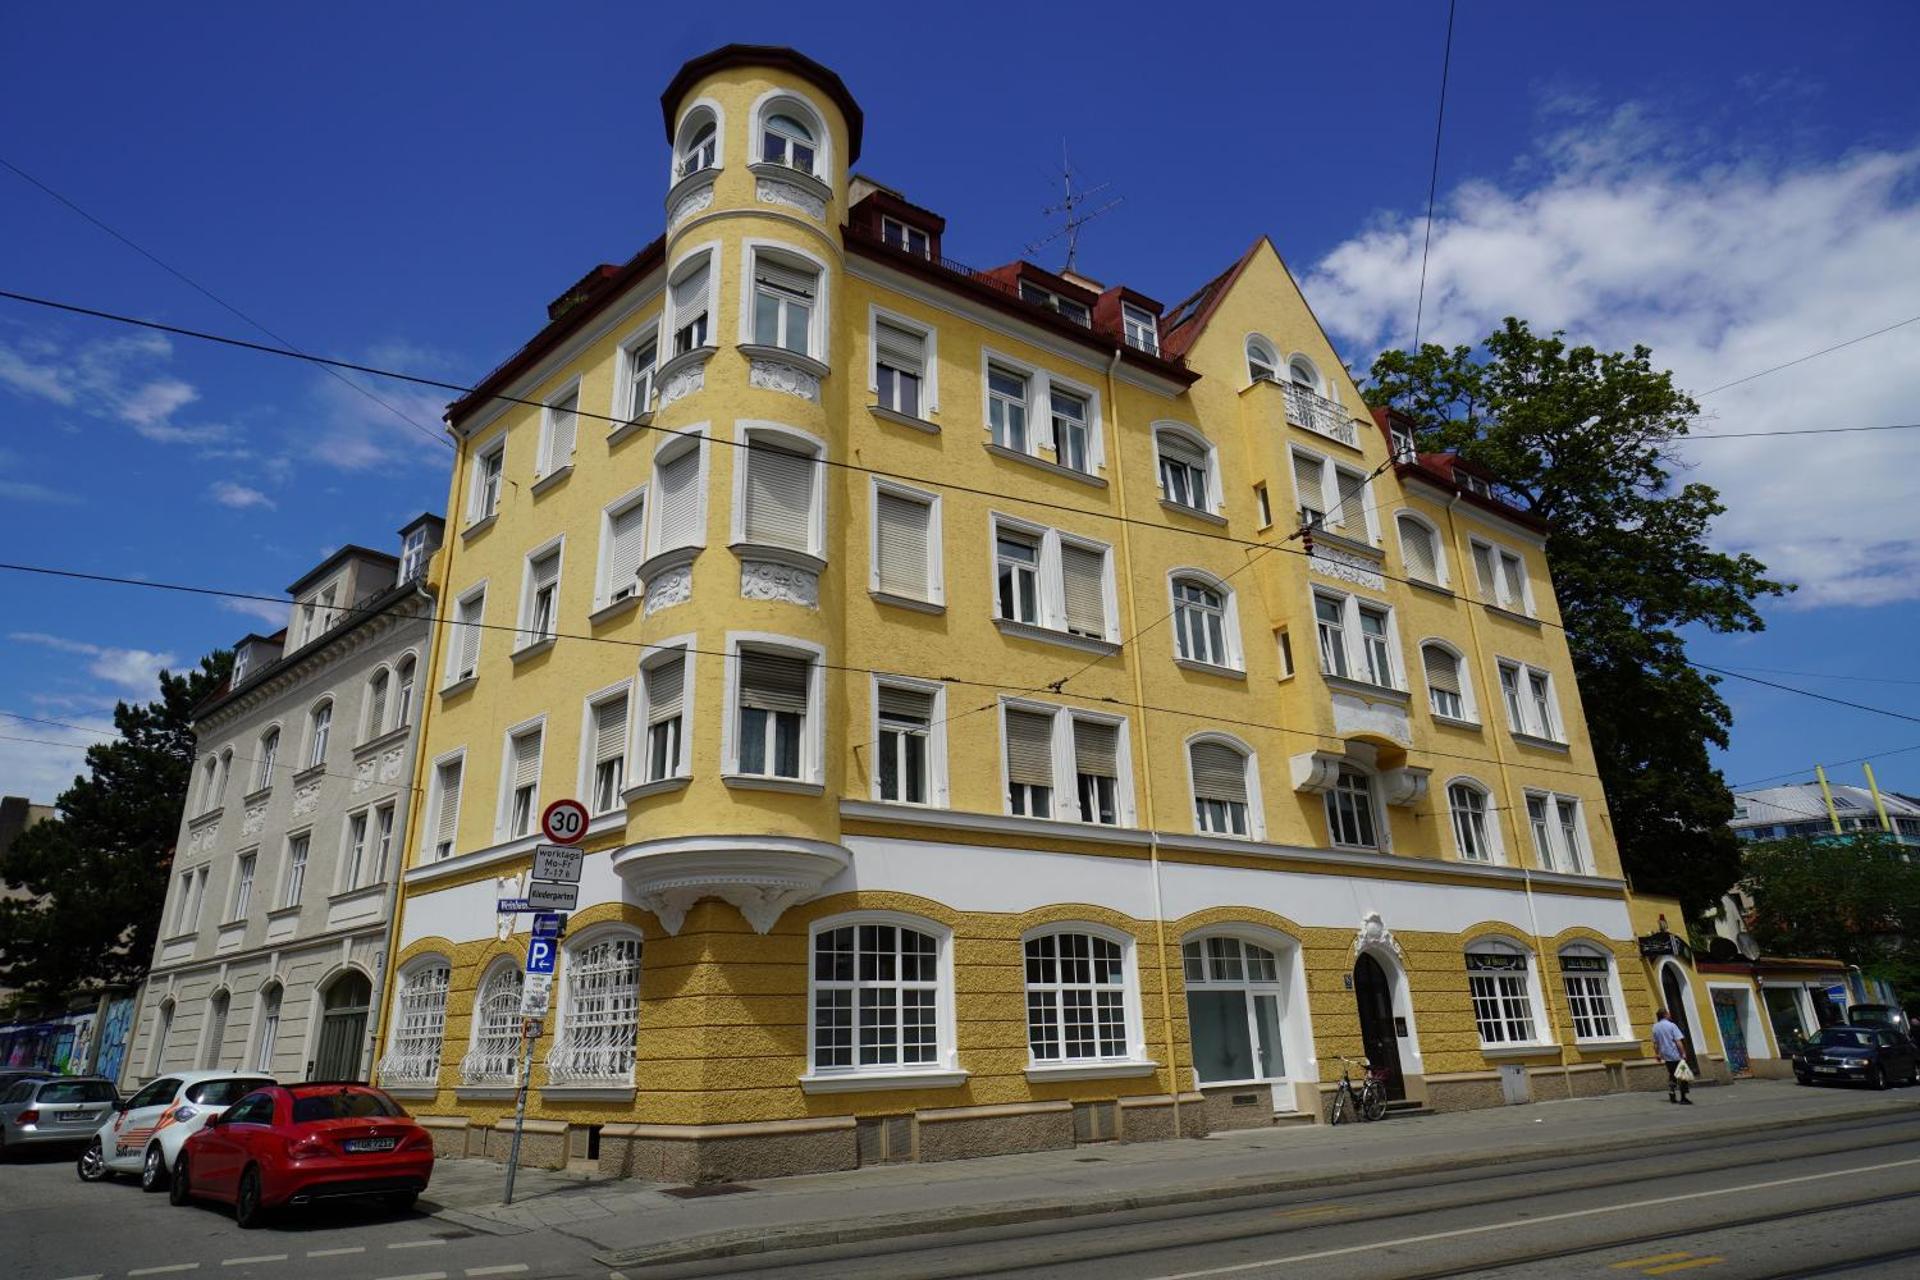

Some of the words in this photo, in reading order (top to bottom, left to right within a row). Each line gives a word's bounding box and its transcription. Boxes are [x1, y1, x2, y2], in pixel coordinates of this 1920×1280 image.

[551, 811, 580, 833] 30
[539, 850, 580, 861] werktags
[544, 859, 572, 868] Mo-Fr
[532, 890, 574, 901] Kindergarten
[531, 943, 548, 969] P
